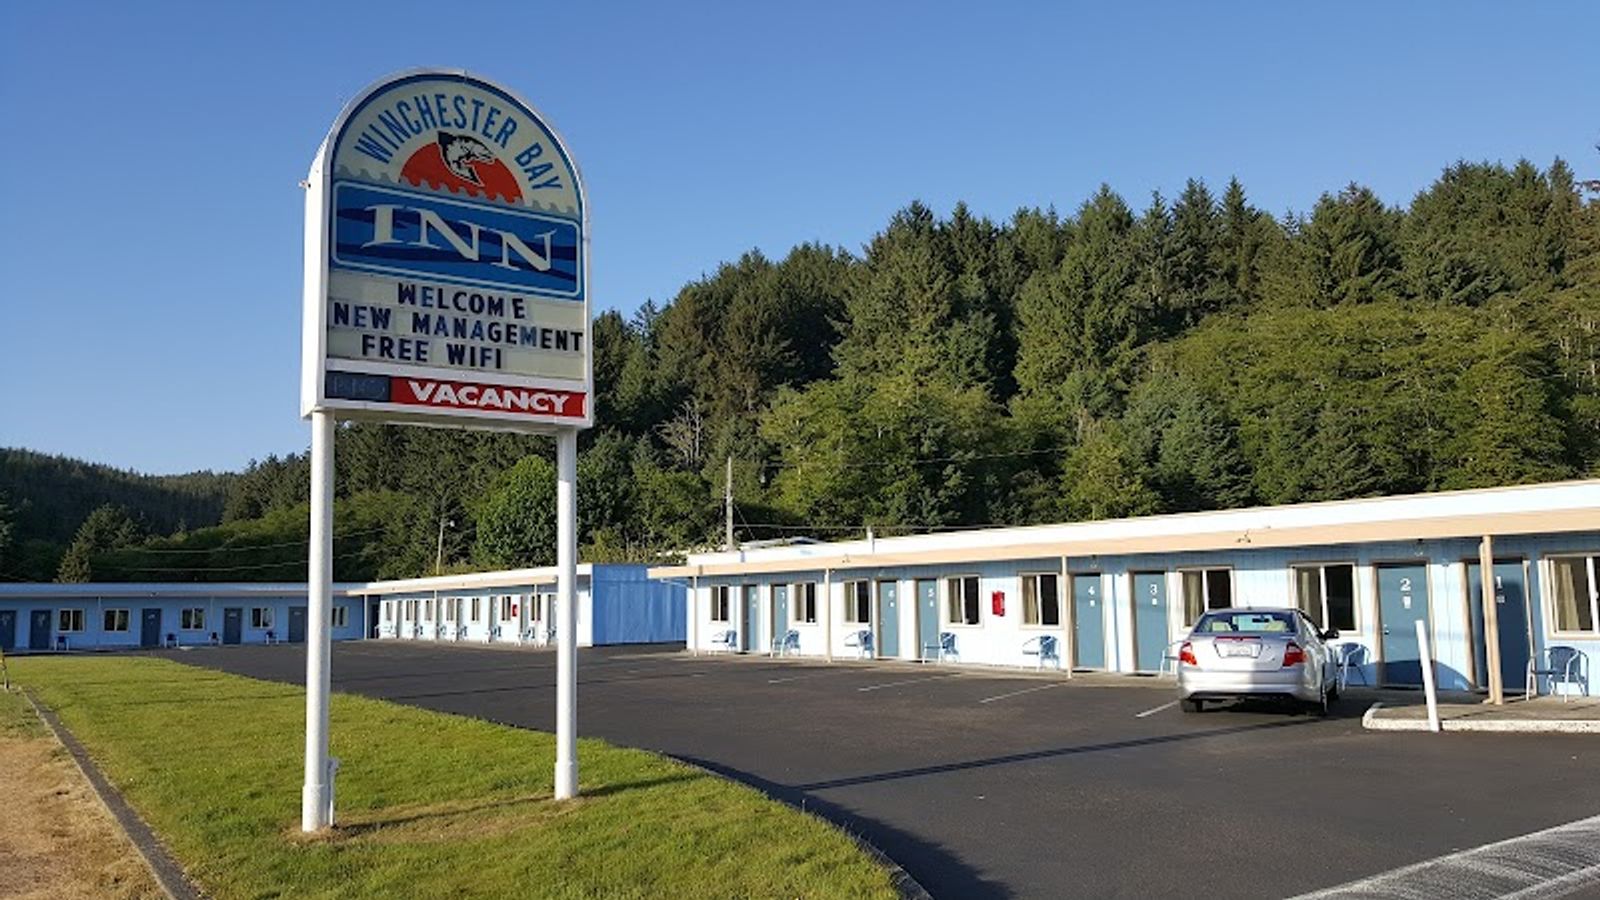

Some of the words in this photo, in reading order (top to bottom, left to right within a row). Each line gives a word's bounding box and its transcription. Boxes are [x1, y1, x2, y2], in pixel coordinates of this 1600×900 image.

[354, 94, 517, 164] WINCHESTER
[514, 142, 562, 190] BAY
[361, 204, 557, 272] INN
[397, 283, 526, 319] WELCOME
[333, 302, 392, 330] NEW
[411, 312, 583, 352] MANAGEMENT
[361, 334, 429, 363] FREE
[446, 343, 502, 369] WIFI
[407, 380, 569, 413] VACANCY
[1088, 585, 1096, 596] 4
[1150, 584, 1158, 595] 3
[1400, 578, 1411, 592] 2
